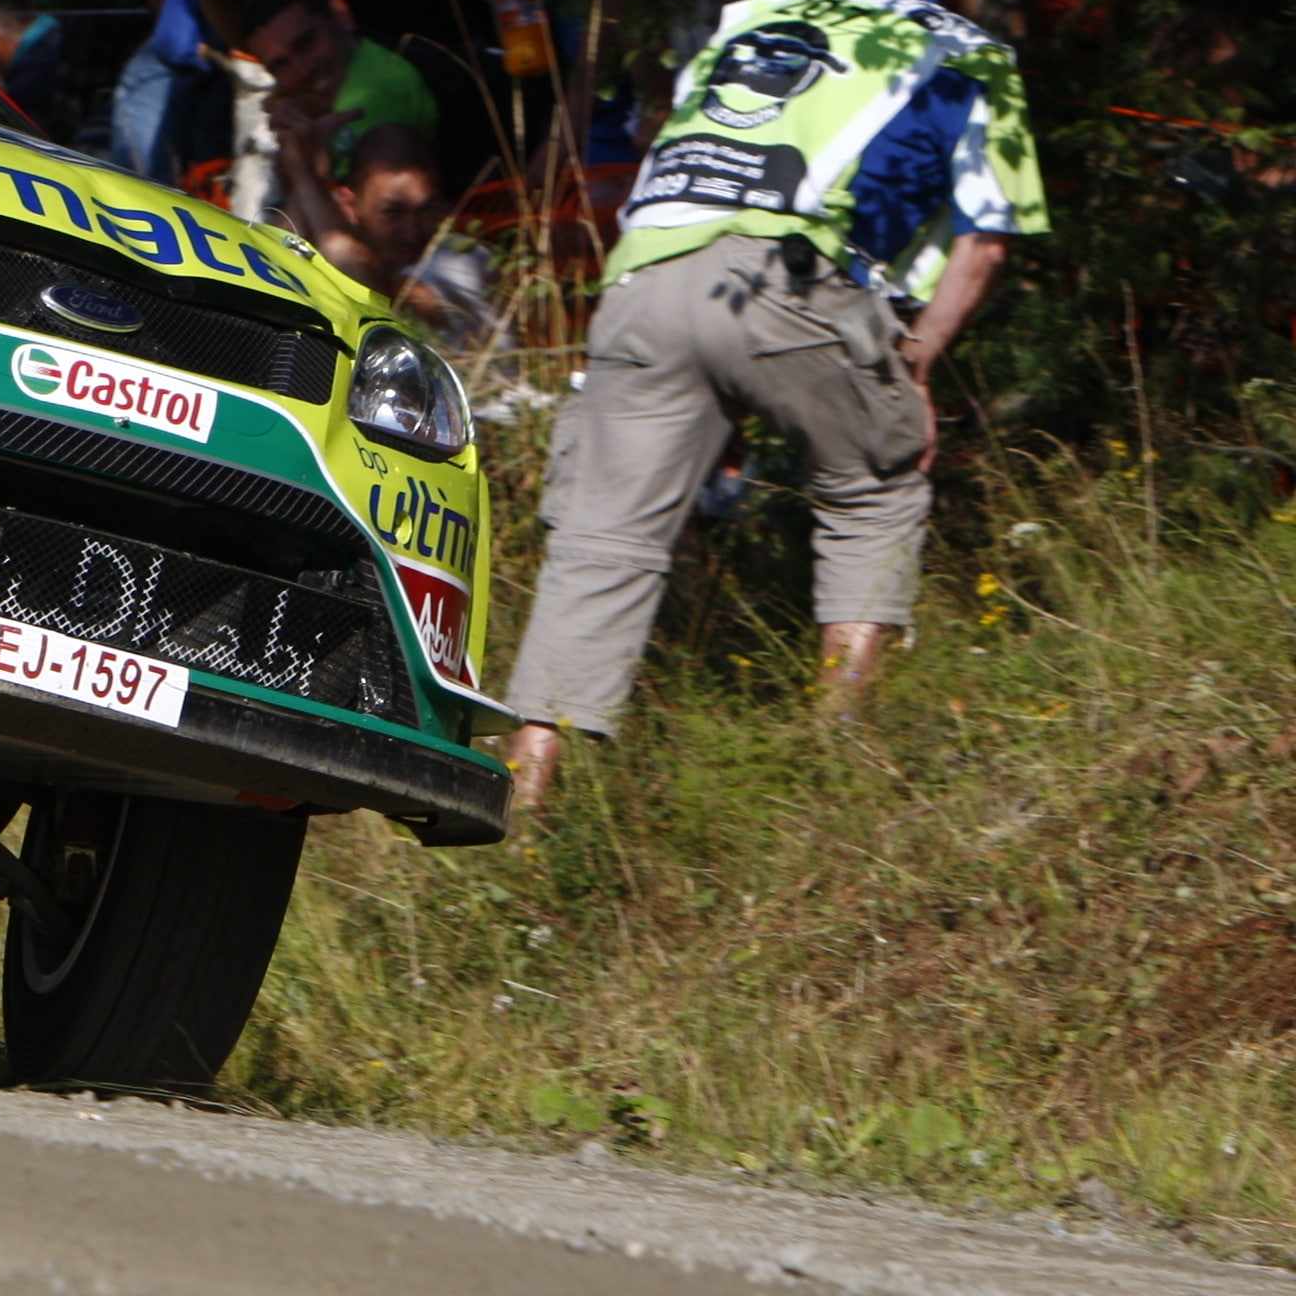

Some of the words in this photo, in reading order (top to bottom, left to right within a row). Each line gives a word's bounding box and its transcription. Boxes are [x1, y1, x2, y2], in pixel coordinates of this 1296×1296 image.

[68, 288, 124, 320] Ford
[64, 357, 206, 436] Castrol
[353, 437, 388, 480] bp
